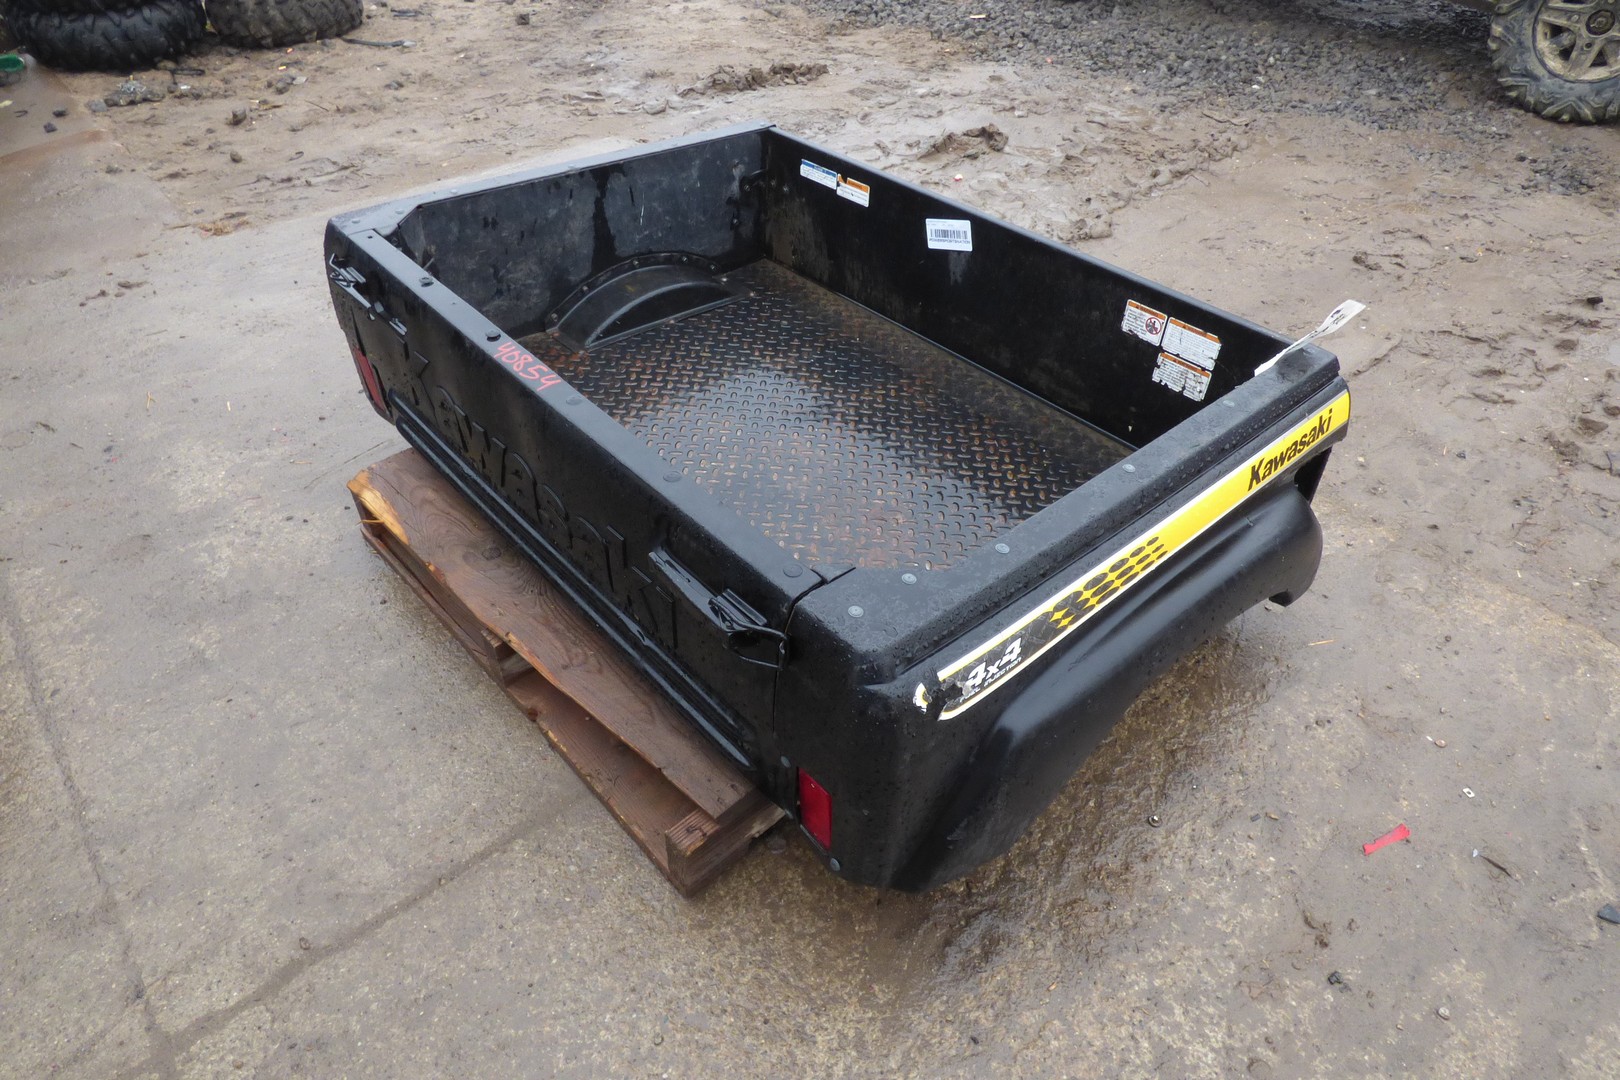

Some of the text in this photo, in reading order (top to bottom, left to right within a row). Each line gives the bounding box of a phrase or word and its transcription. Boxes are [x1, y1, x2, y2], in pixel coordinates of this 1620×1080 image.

[493, 341, 562, 392] 40854
[1247, 408, 1333, 492] Kawasaki
[965, 637, 1021, 688] 4x4
